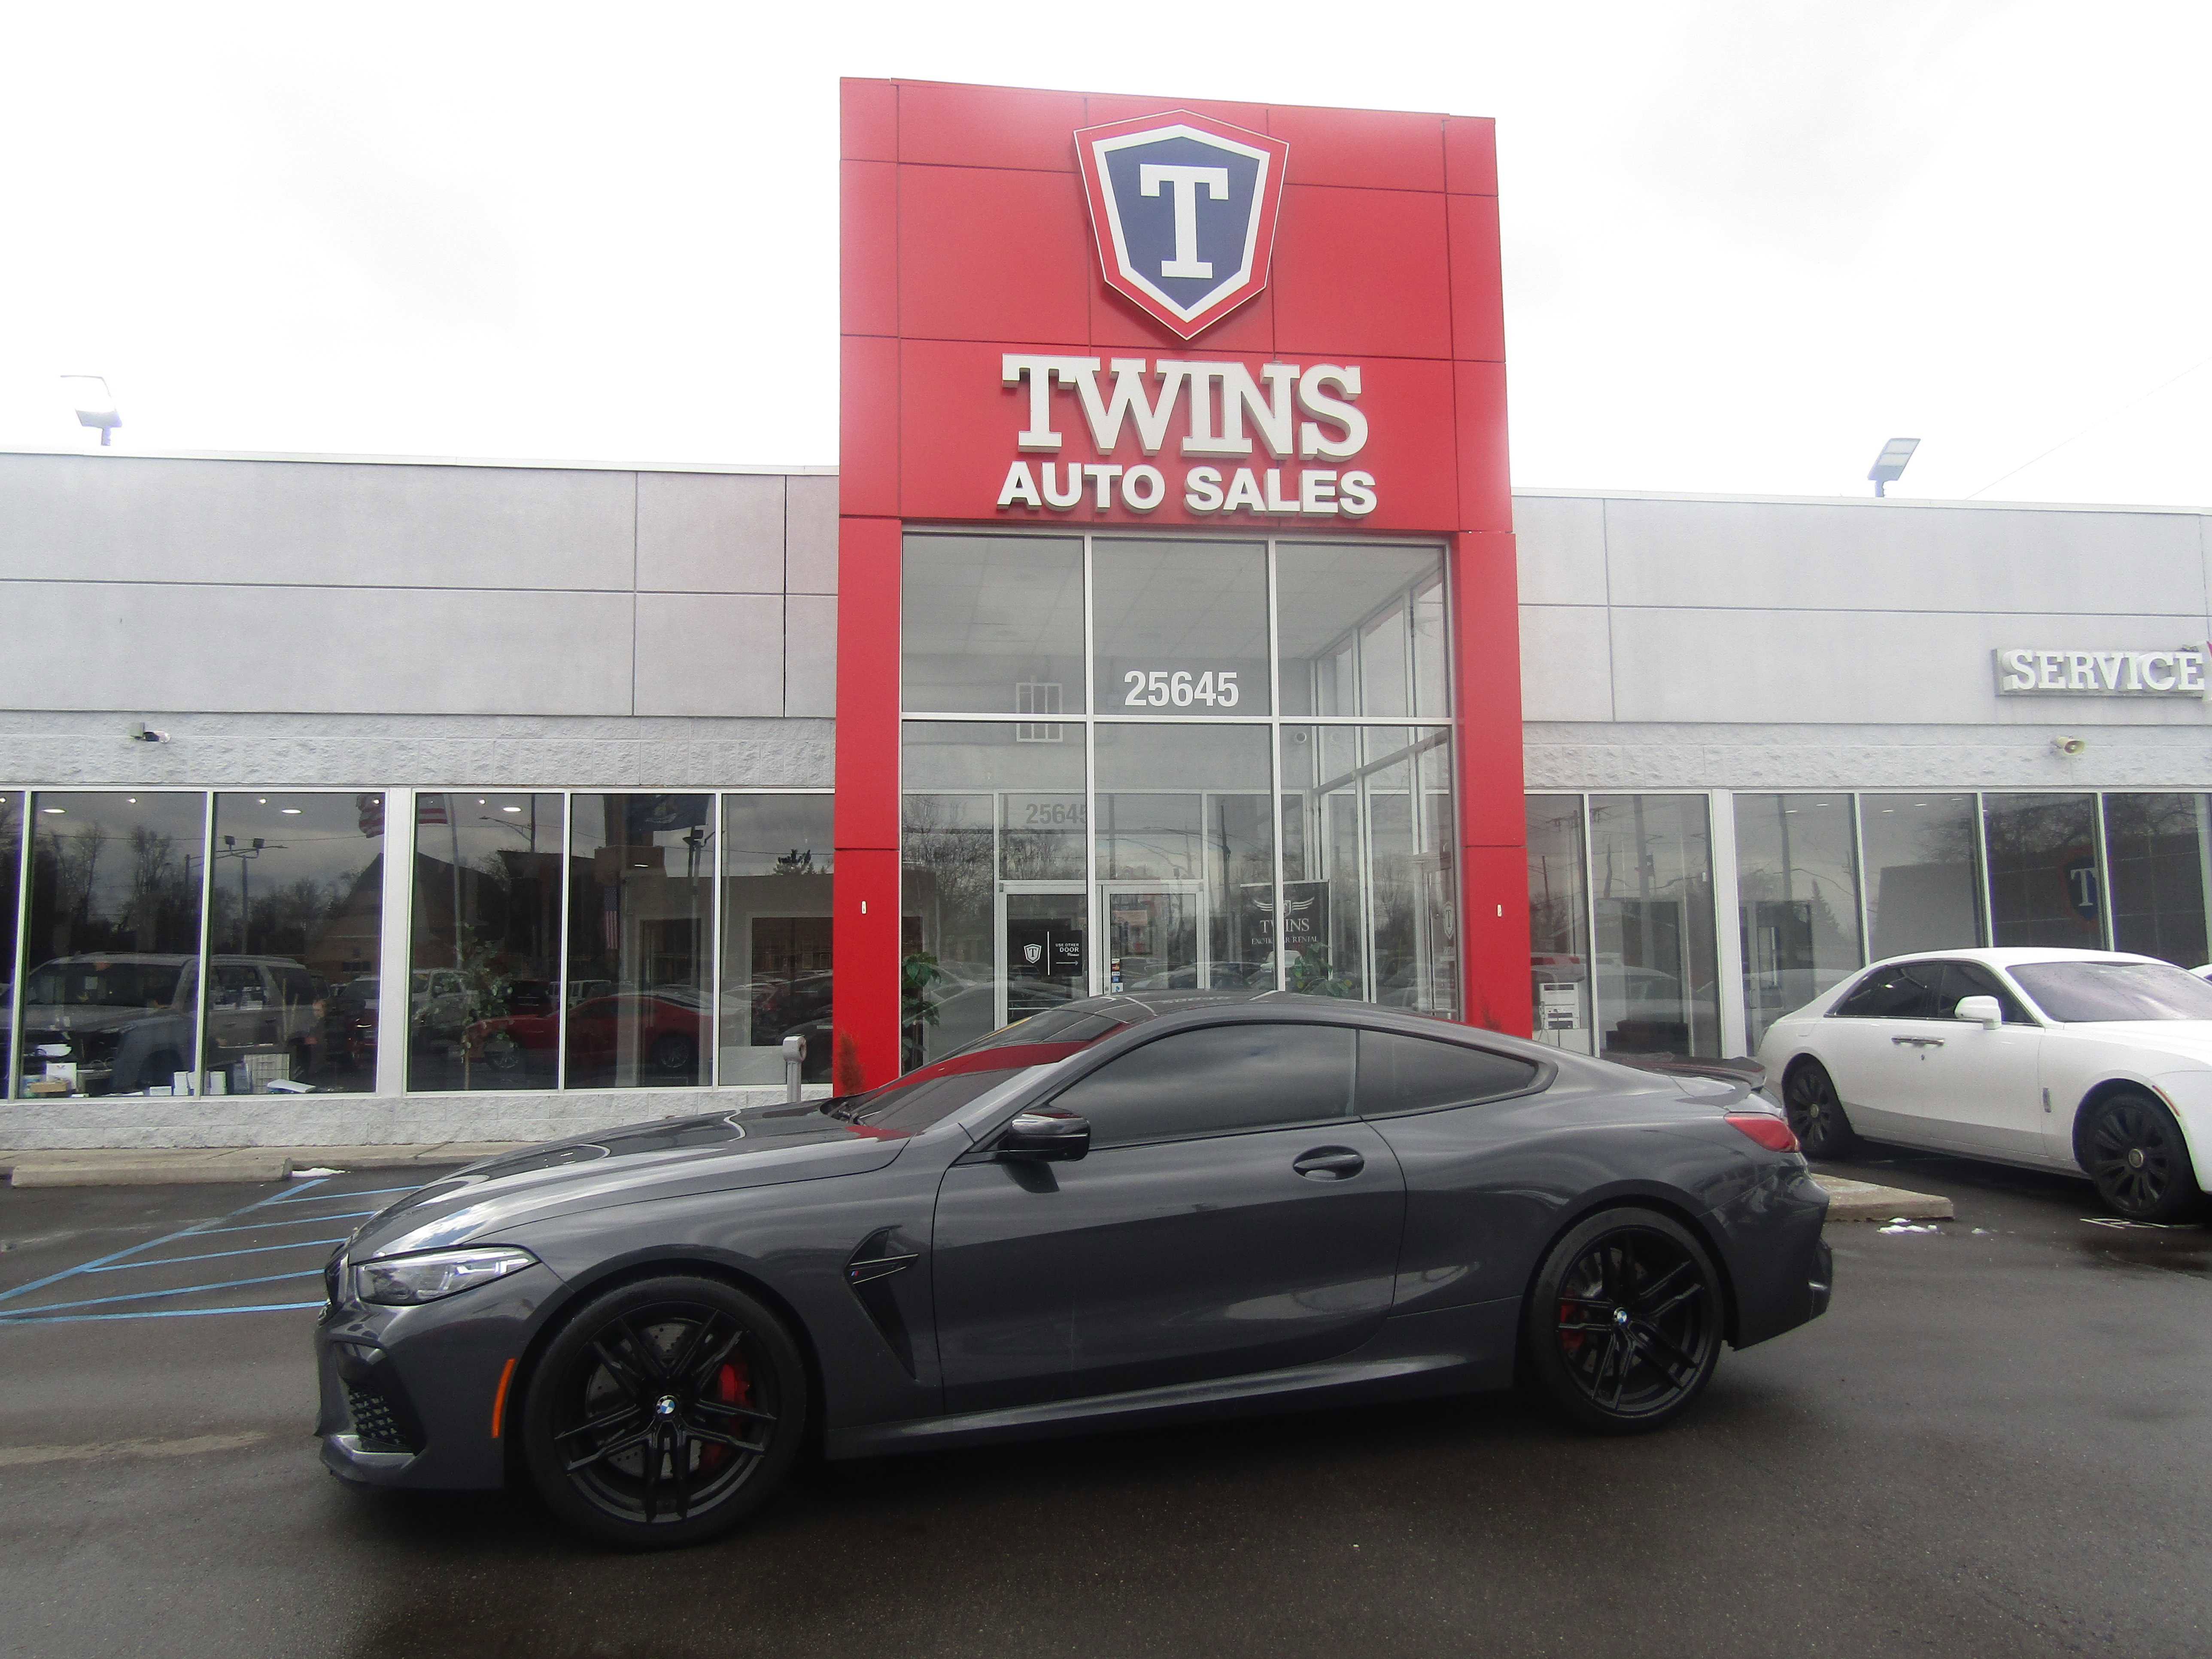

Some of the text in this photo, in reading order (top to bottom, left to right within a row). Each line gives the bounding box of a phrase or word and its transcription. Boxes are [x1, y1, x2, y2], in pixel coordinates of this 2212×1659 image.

[1139, 164, 1229, 279] T
[1002, 353, 1369, 462] TWINS
[997, 460, 1377, 519] AUTO SALES
[1124, 671, 1239, 707] 25645
[2002, 649, 2205, 690] SERVICE
[1260, 918, 1310, 933] TINS
